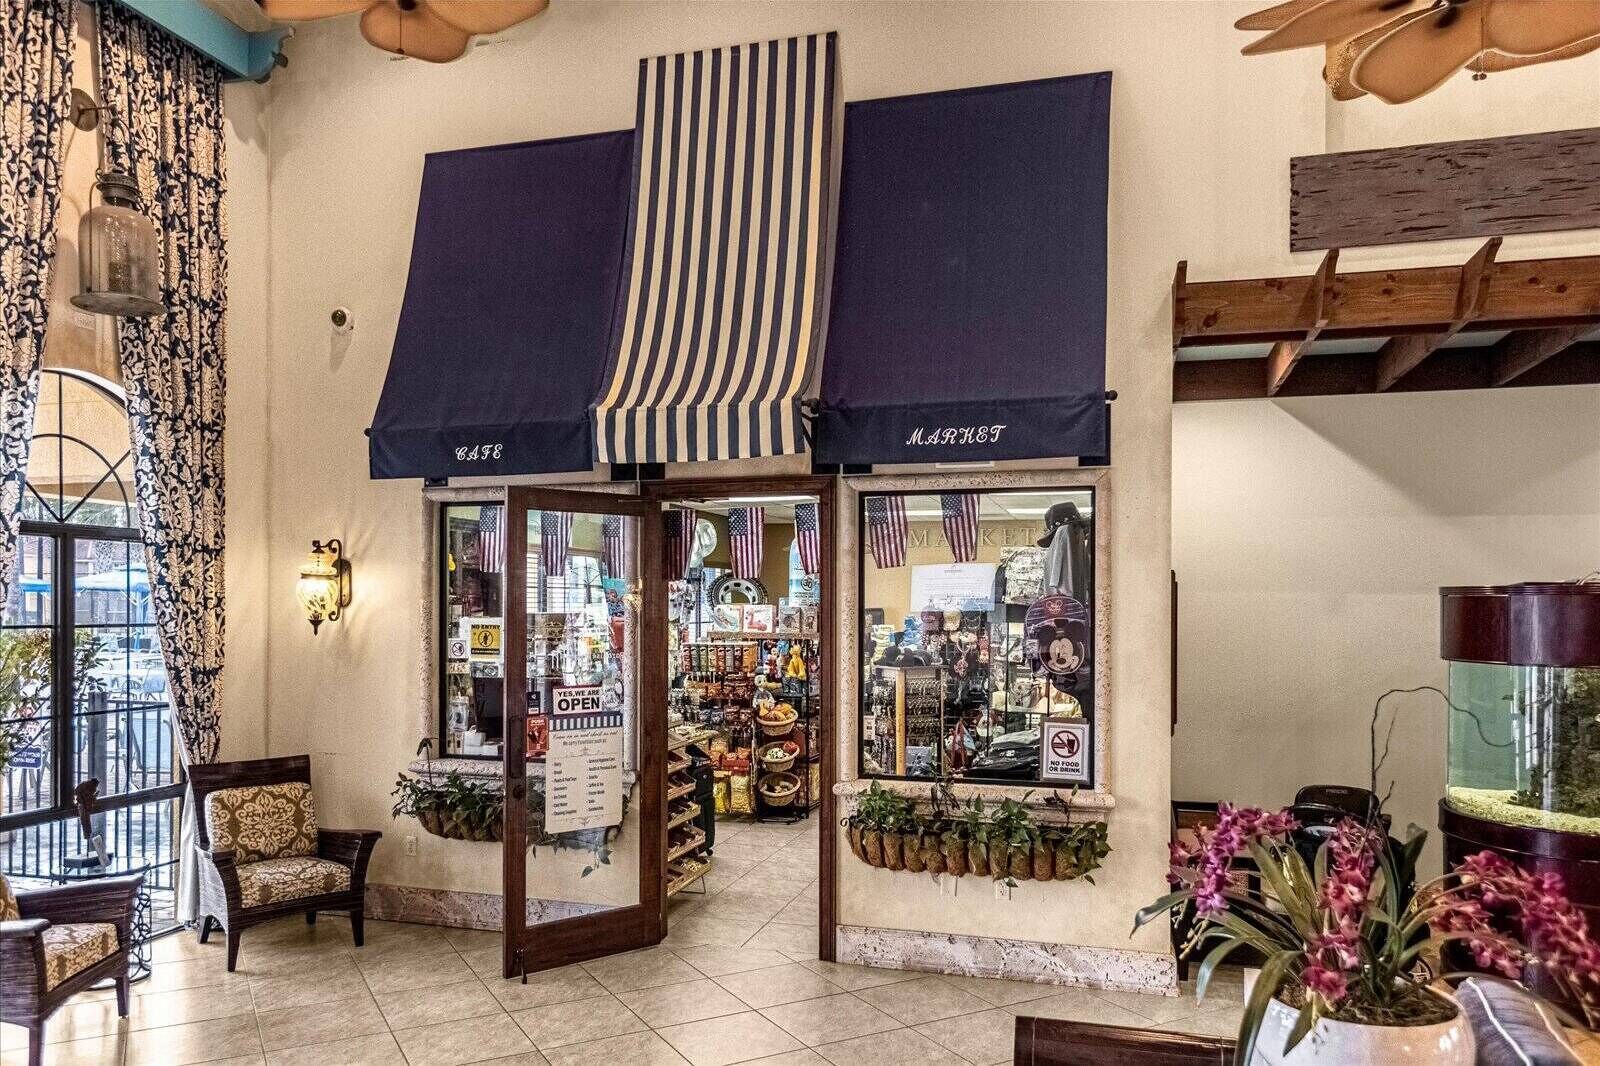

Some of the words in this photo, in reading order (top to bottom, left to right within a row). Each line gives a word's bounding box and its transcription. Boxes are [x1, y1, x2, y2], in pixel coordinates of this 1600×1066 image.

[906, 425, 1007, 445] MARKET
[455, 443, 503, 461] CAFE
[908, 527, 1036, 548] MAKET
[557, 696, 600, 711] OPEN
